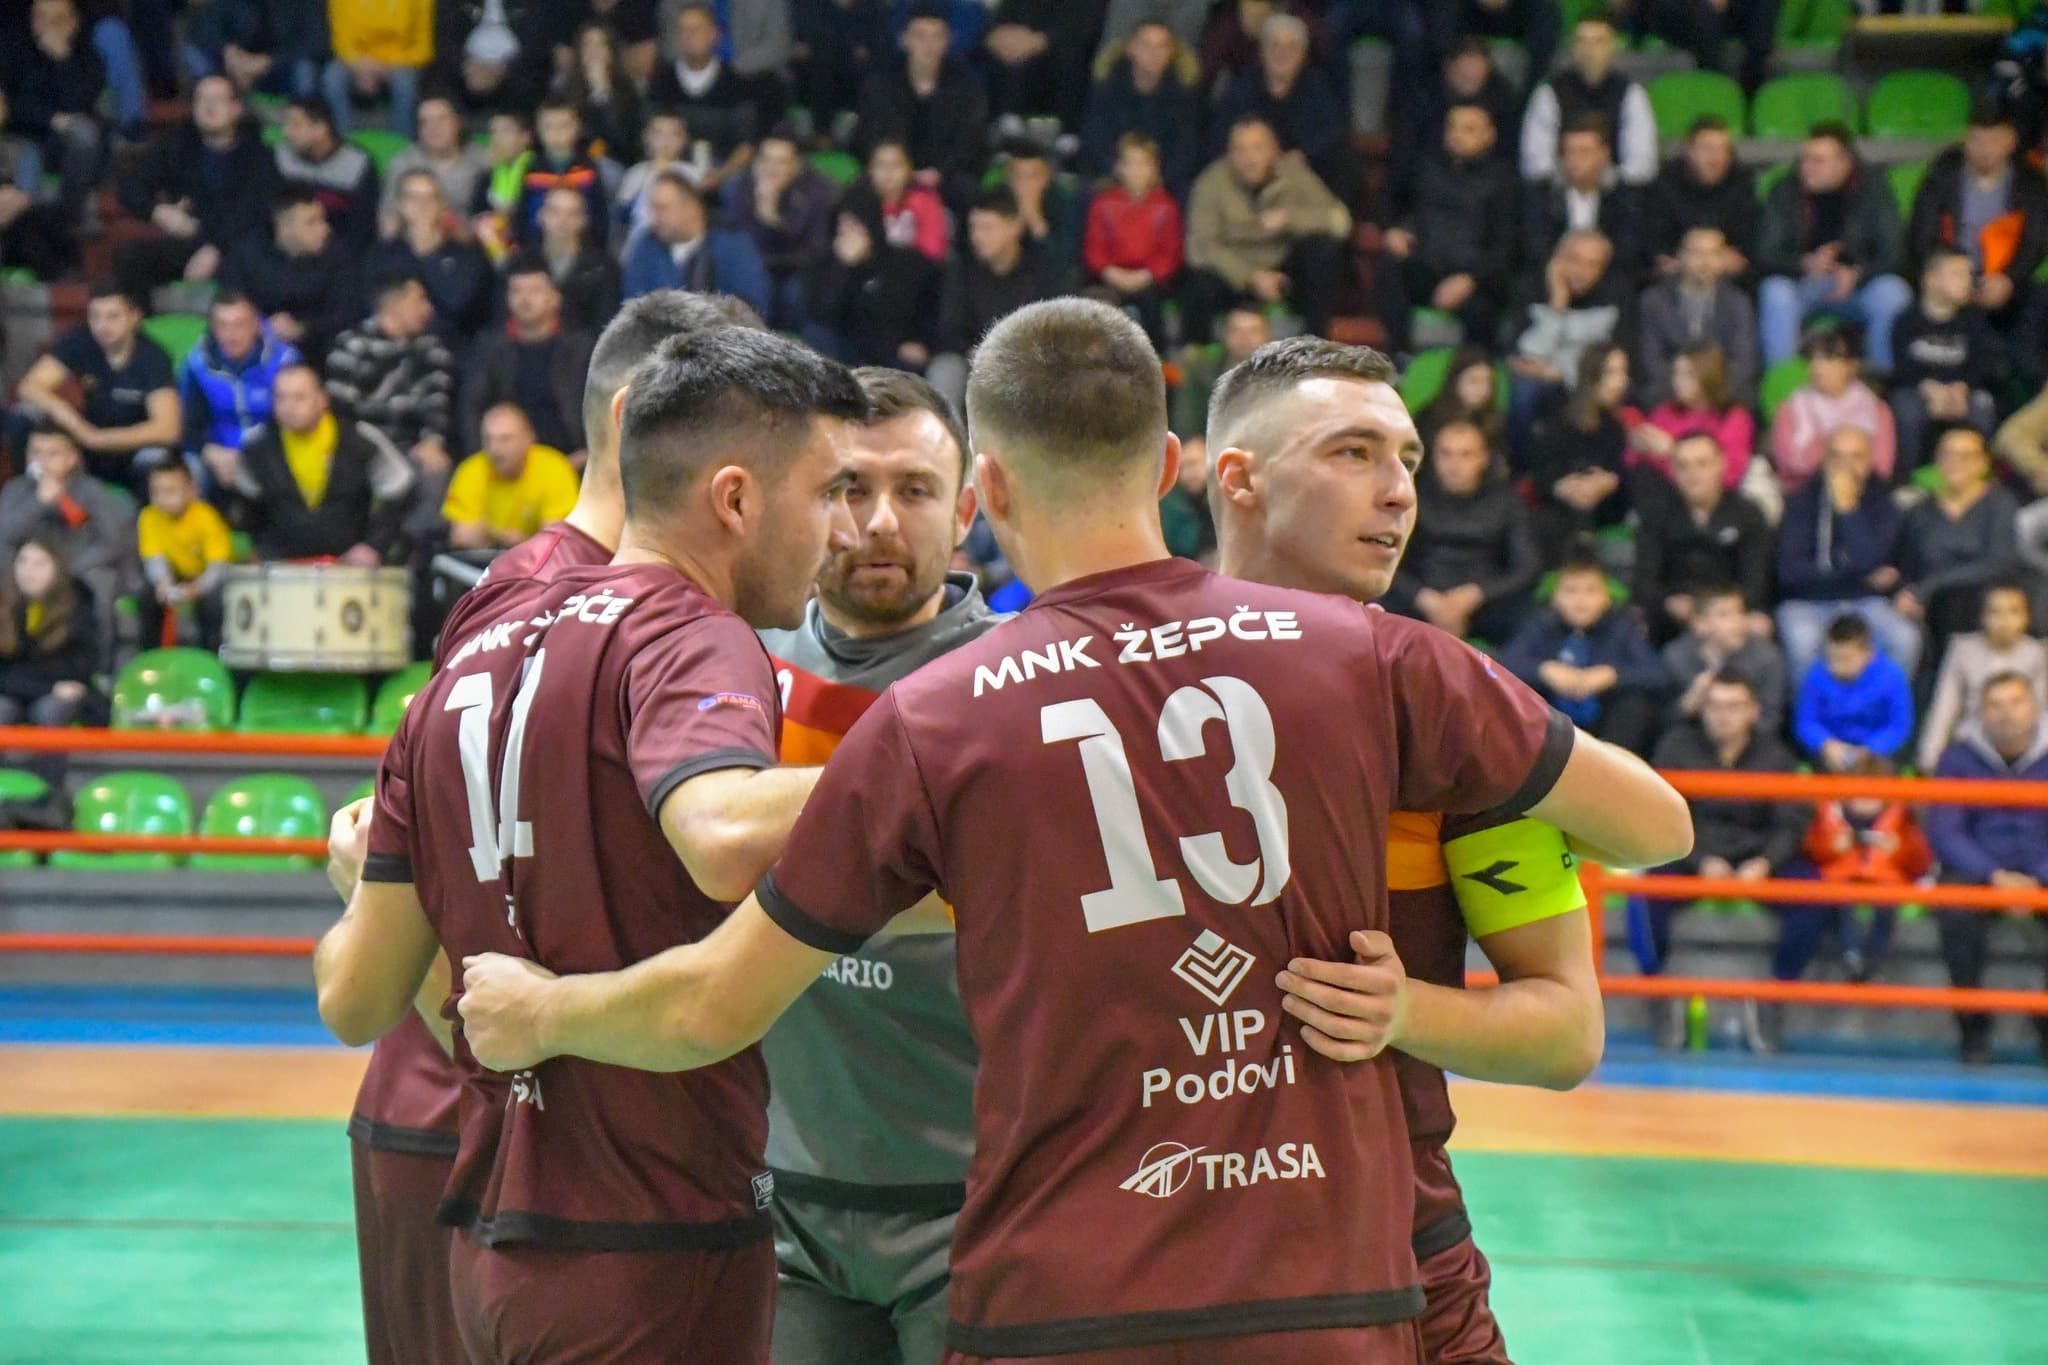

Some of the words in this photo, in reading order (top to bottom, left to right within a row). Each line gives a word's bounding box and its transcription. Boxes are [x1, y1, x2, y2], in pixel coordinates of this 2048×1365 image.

[973, 635, 1102, 698] MNK
[1113, 604, 1303, 664] ŽEPČE
[1040, 675, 1292, 934] 13
[1178, 1009, 1266, 1056] VIP
[1142, 1044, 1296, 1108] Podovi
[1197, 1142, 1327, 1190] TRASA
